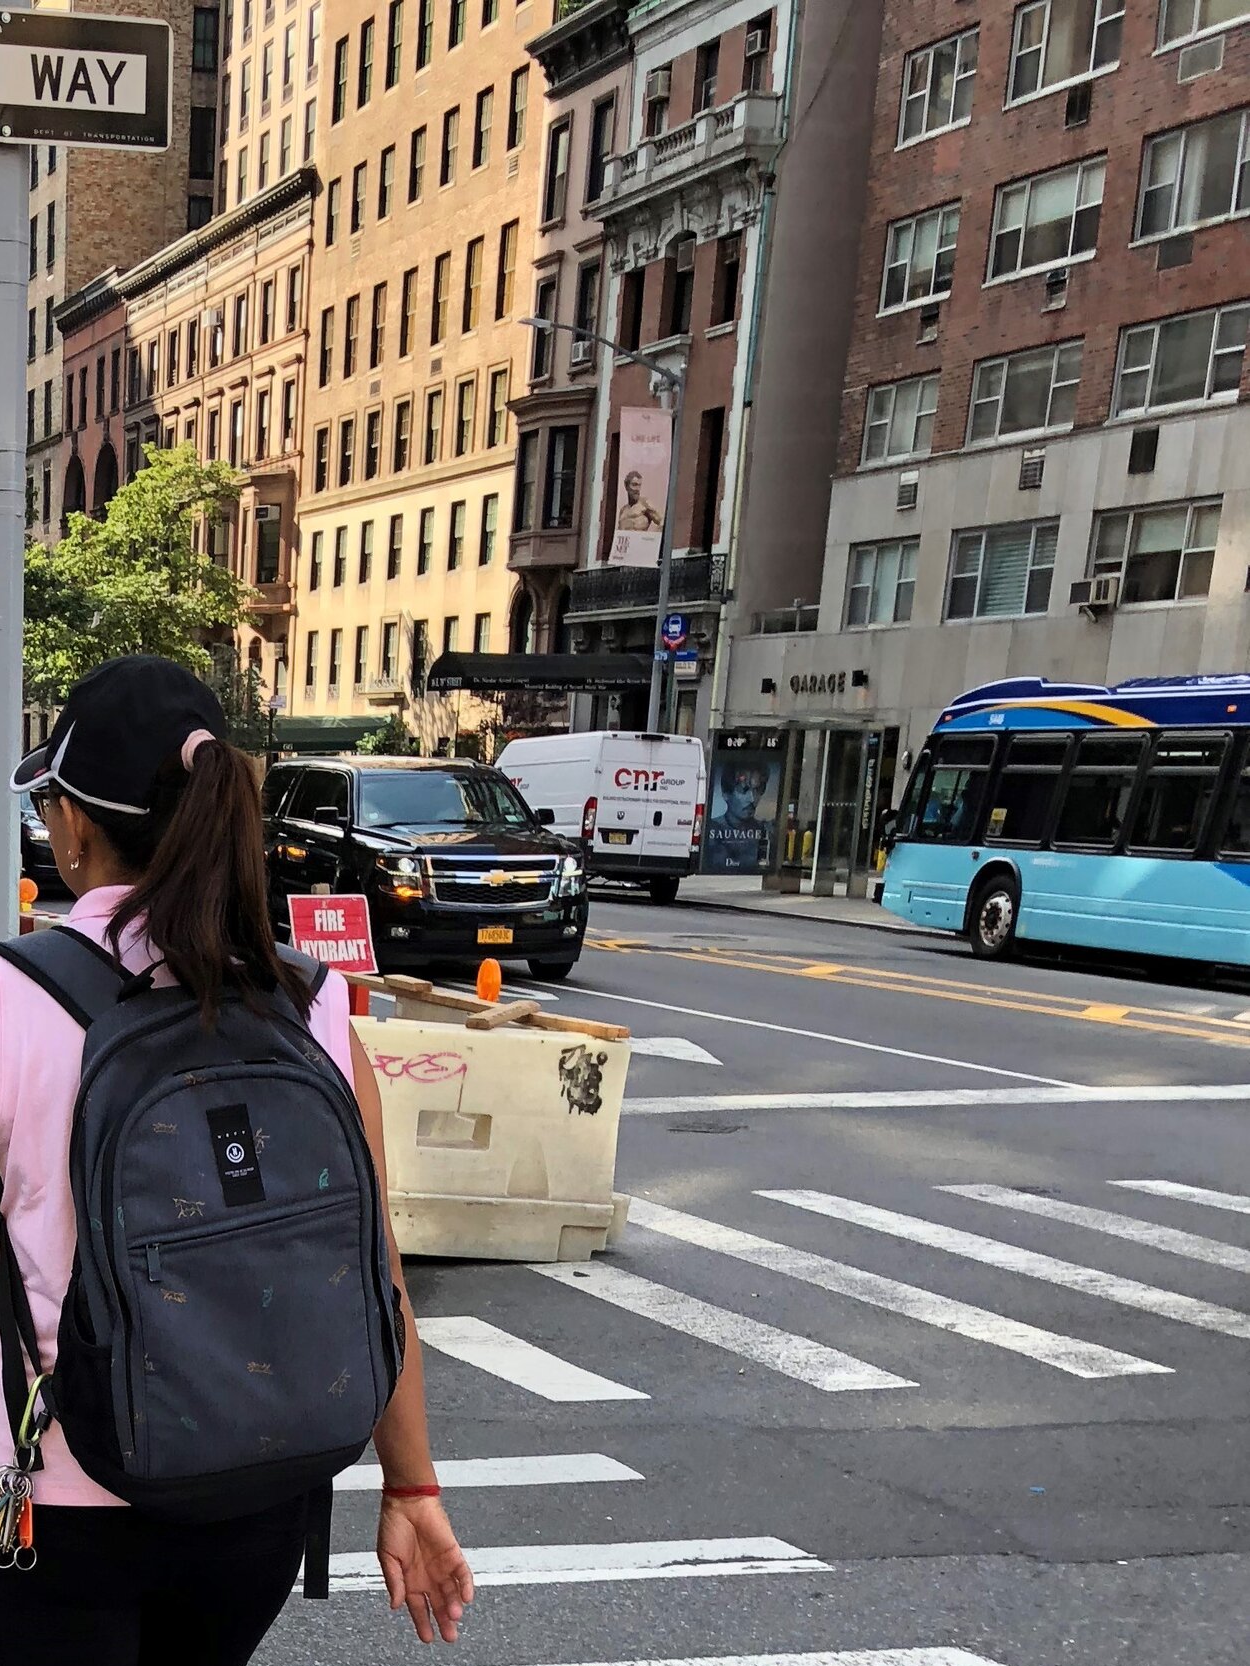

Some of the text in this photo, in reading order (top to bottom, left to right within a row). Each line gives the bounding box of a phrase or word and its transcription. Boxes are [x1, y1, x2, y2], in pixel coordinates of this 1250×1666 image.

[30, 53, 127, 106] WAY
[33, 128, 55, 136] DEPT
[83, 132, 155, 143] TRANSPORTATION
[660, 778, 686, 786] GROUP
[710, 828, 762, 840] SAUVAGE
[314, 909, 347, 932] FIRE
[300, 938, 367, 963] HYDRANT
